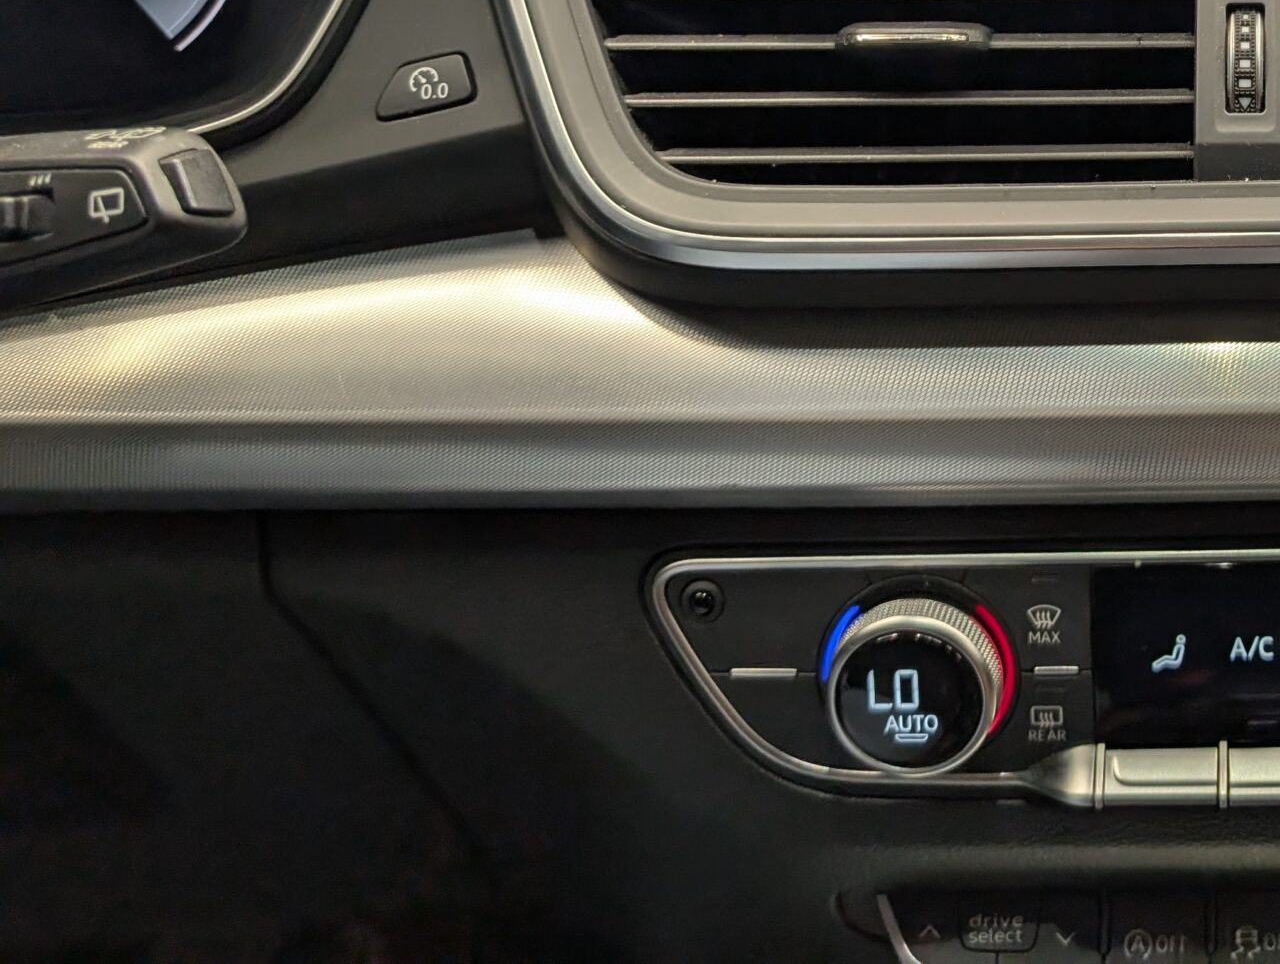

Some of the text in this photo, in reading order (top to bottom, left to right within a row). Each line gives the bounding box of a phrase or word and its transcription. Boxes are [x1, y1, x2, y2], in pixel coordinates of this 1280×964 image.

[421, 82, 449, 99] 0.0
[1027, 631, 1061, 644] MAX
[1229, 635, 1274, 662] A/C
[867, 668, 920, 712] LO
[884, 714, 939, 734] AUTO
[1028, 729, 1067, 741] REAR
[969, 913, 1025, 927] drive
[969, 928, 1023, 943] select
